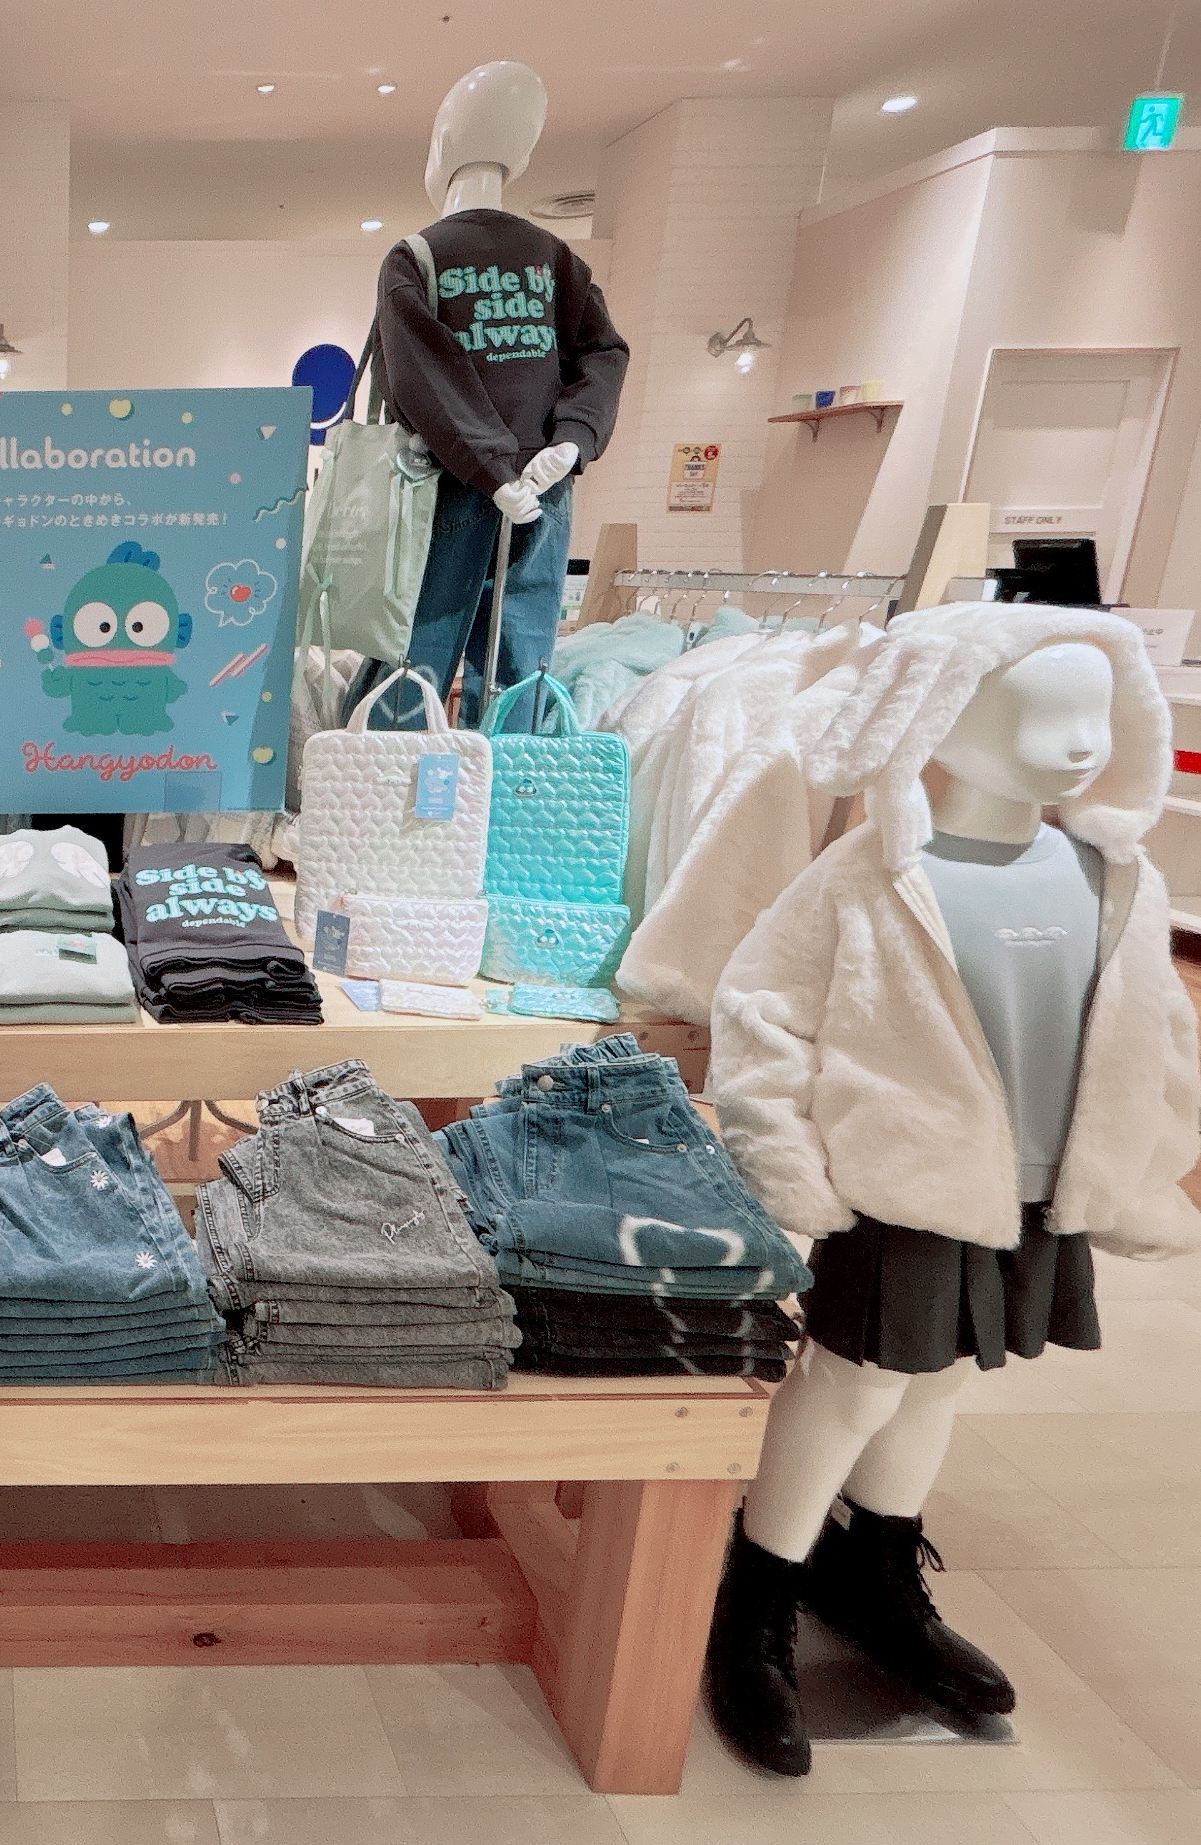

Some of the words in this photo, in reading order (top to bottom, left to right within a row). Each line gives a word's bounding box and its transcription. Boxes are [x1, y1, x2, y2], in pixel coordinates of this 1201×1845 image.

[437, 265, 519, 298] Side
[524, 262, 555, 303] by
[473, 291, 544, 320] side
[486, 348, 546, 362] dependable
[1004, 515, 1035, 525] STAFF
[1036, 516, 1062, 525] ONLY
[20, 741, 217, 782] Hangyodon
[135, 863, 218, 886] Side
[222, 866, 268, 891] by
[168, 877, 247, 897] side
[145, 895, 278, 923] always
[181, 916, 246, 928] dependable
